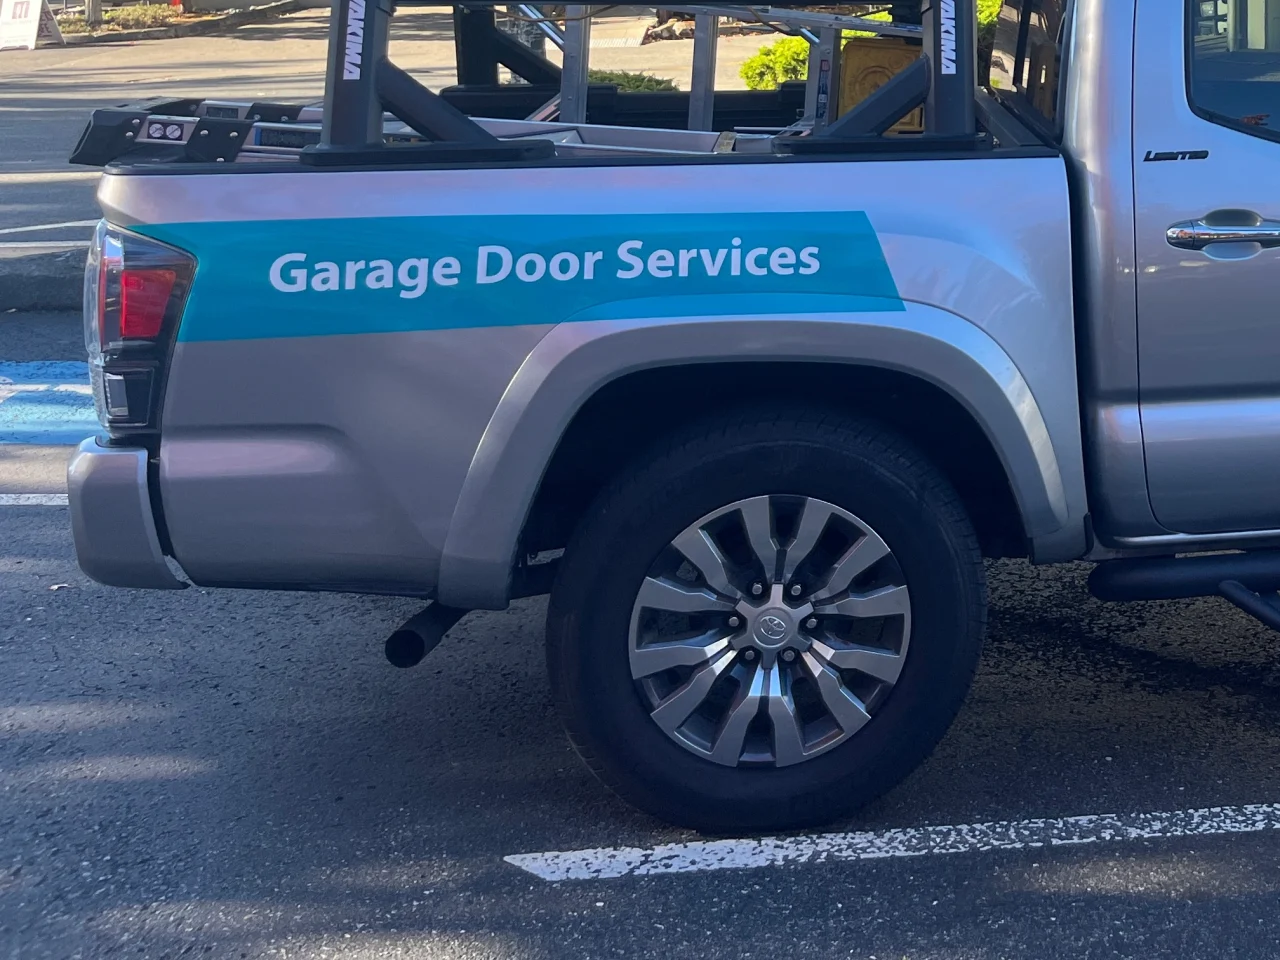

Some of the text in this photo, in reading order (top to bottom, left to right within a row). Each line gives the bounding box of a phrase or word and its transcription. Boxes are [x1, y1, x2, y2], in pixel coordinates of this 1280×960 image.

[269, 237, 821, 299] Garage Door Services
